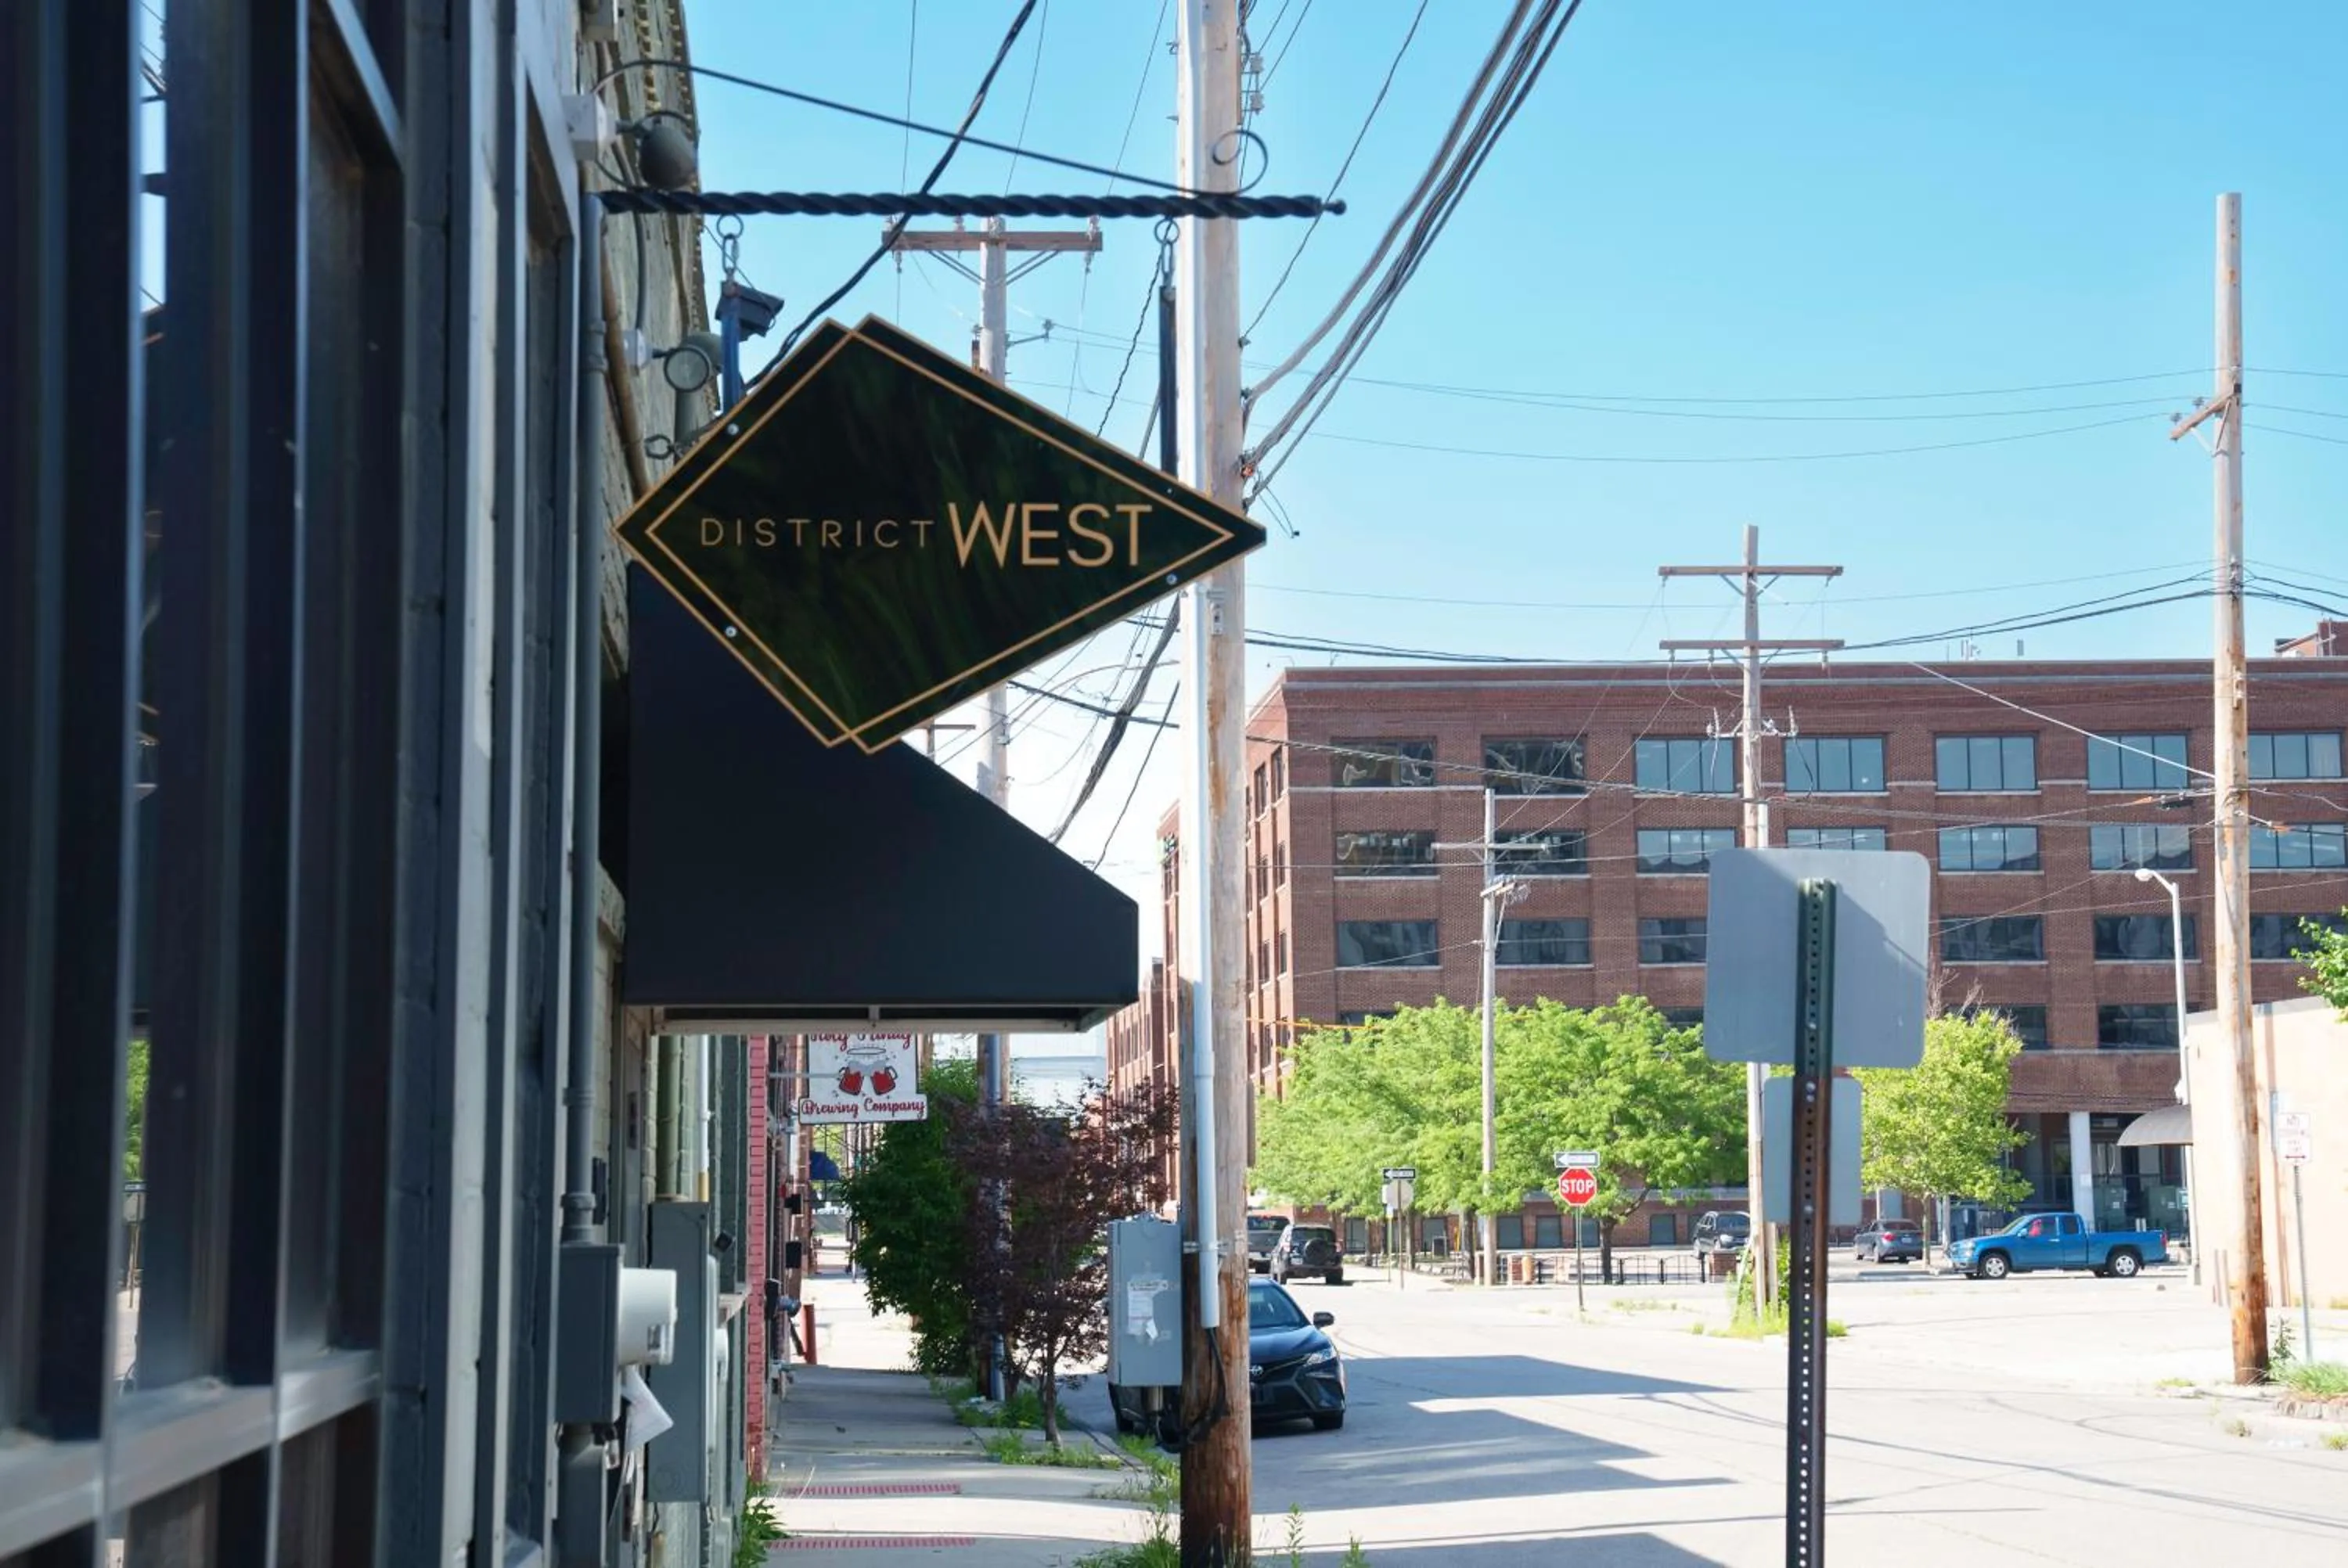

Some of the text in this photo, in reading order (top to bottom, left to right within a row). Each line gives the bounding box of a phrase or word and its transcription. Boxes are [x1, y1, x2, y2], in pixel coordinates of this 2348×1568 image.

[701, 502, 1153, 568] DISTRICT WEST
[801, 1098, 925, 1119] Brewing Company
[1561, 1179, 1594, 1193] STOP
